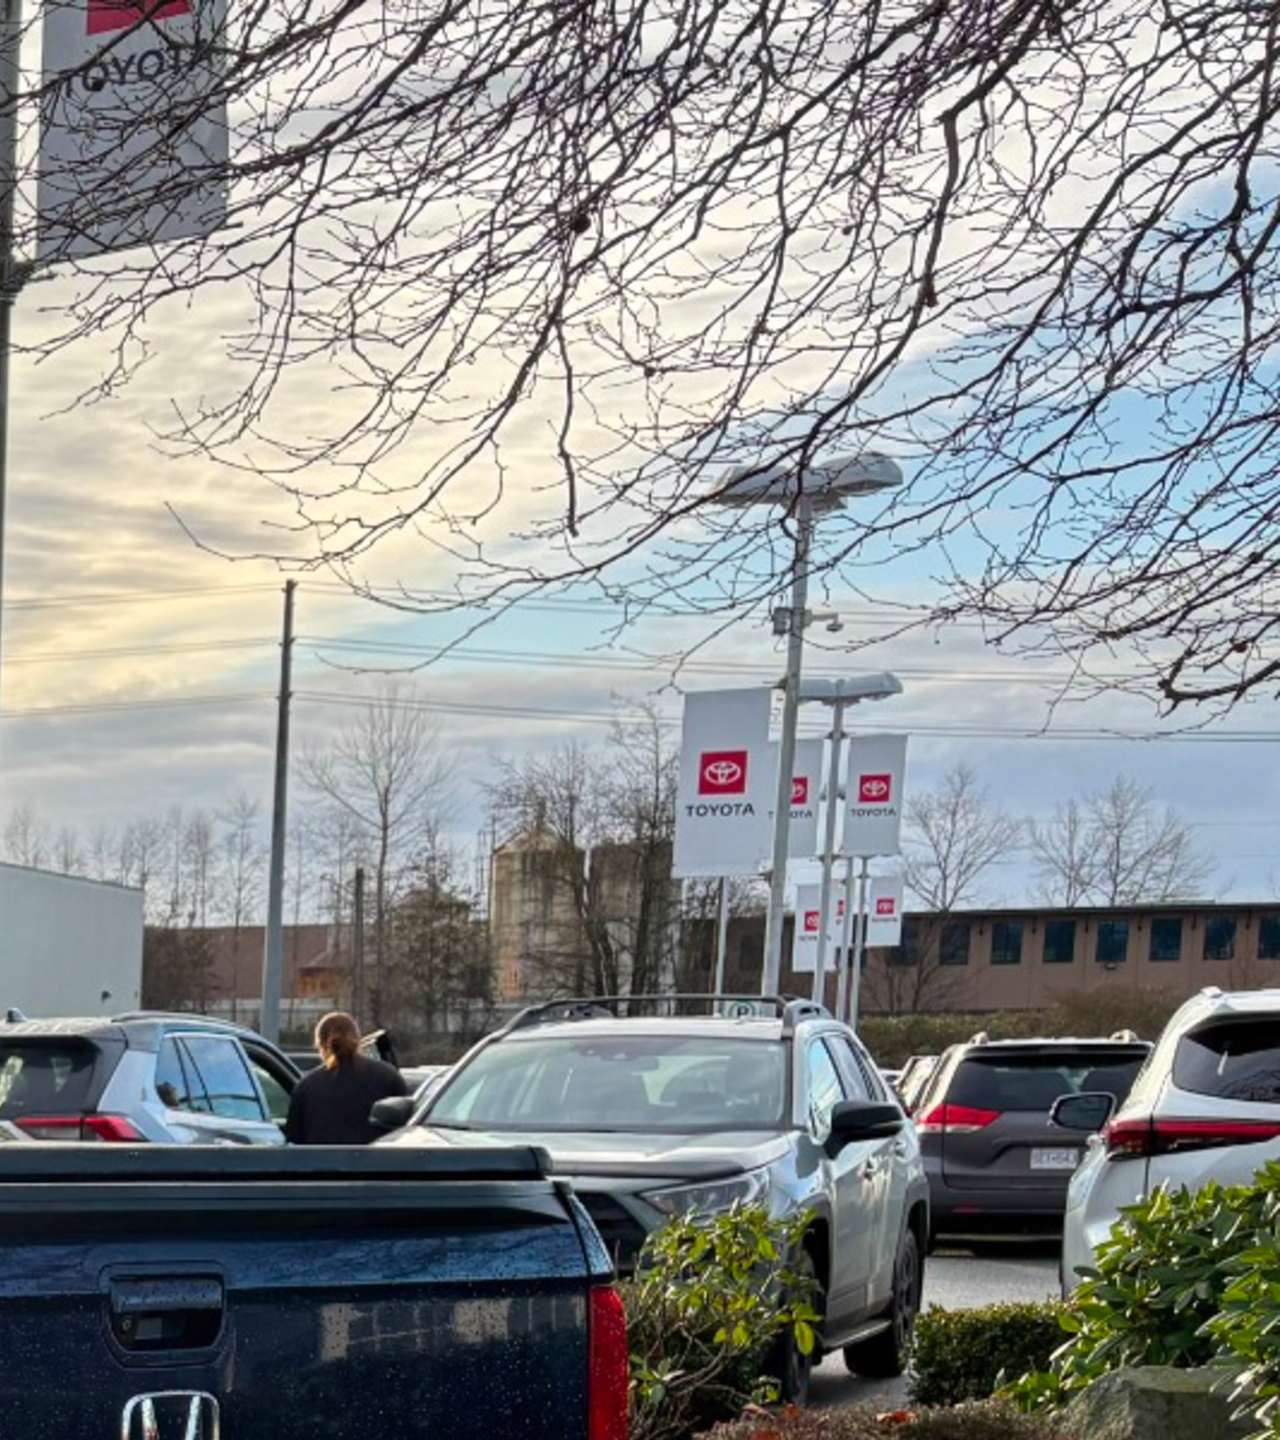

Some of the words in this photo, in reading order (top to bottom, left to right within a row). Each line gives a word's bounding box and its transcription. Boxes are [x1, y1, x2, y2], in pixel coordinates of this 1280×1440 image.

[686, 803, 755, 817] TOYOTA
[768, 809, 813, 819] TOTA
[851, 808, 897, 817] TOYOTA
